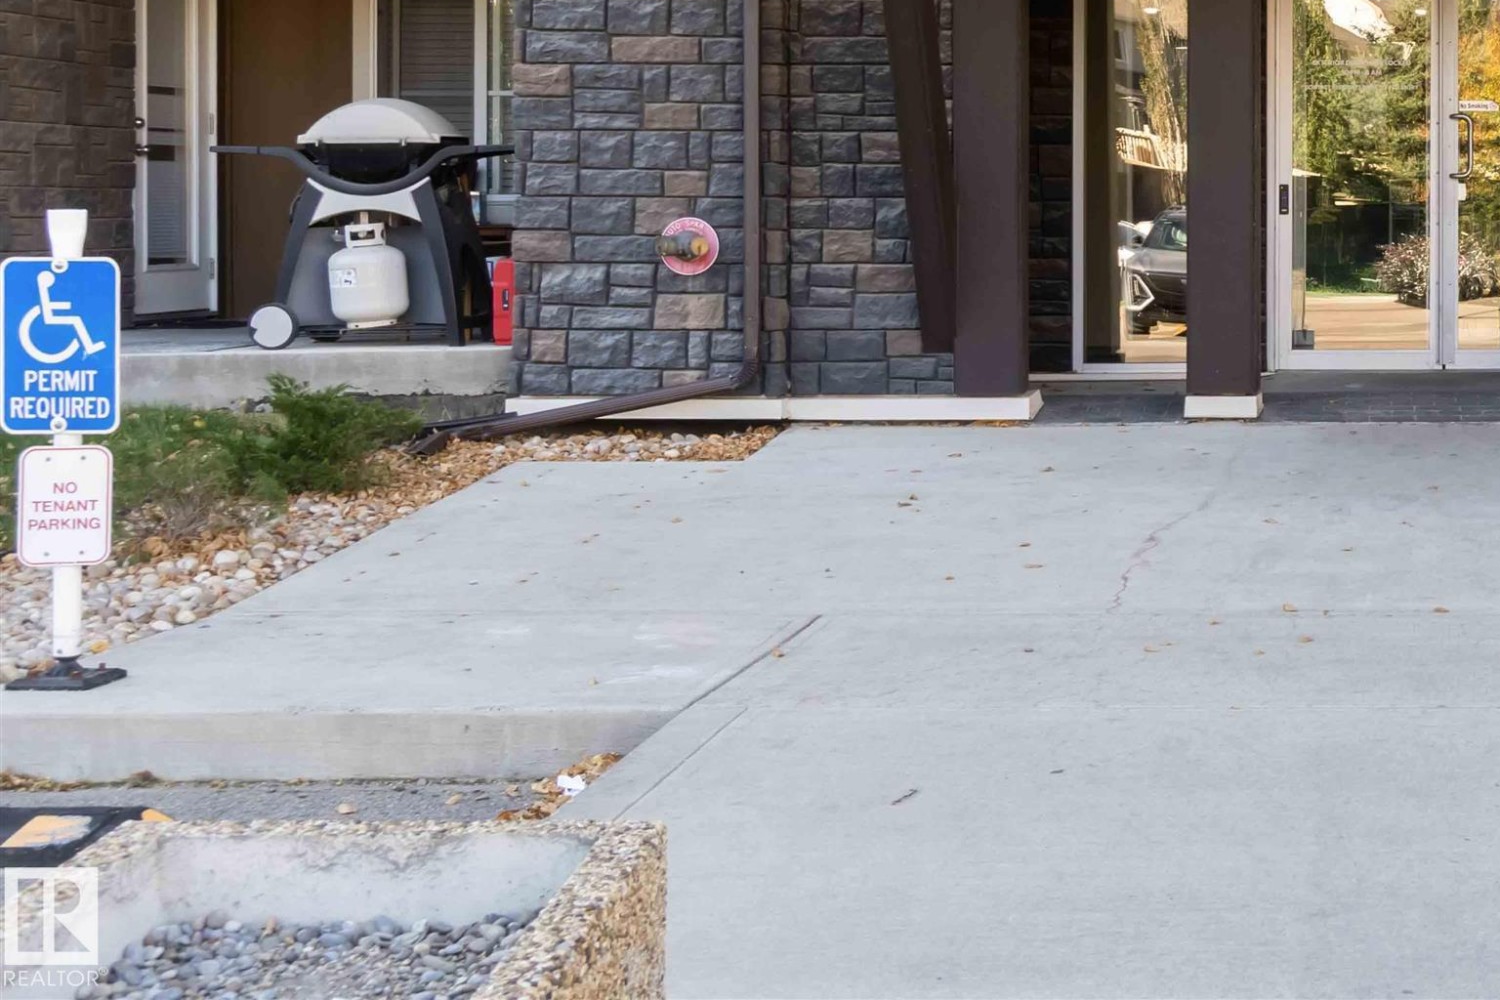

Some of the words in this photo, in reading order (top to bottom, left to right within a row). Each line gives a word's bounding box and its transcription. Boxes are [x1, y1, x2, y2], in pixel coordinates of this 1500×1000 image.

[24, 370, 98, 392] PERMIT
[10, 396, 110, 419] REQUIRED
[53, 482, 77, 494] NO
[32, 500, 98, 512] TENANT
[28, 517, 101, 531] PARKING
